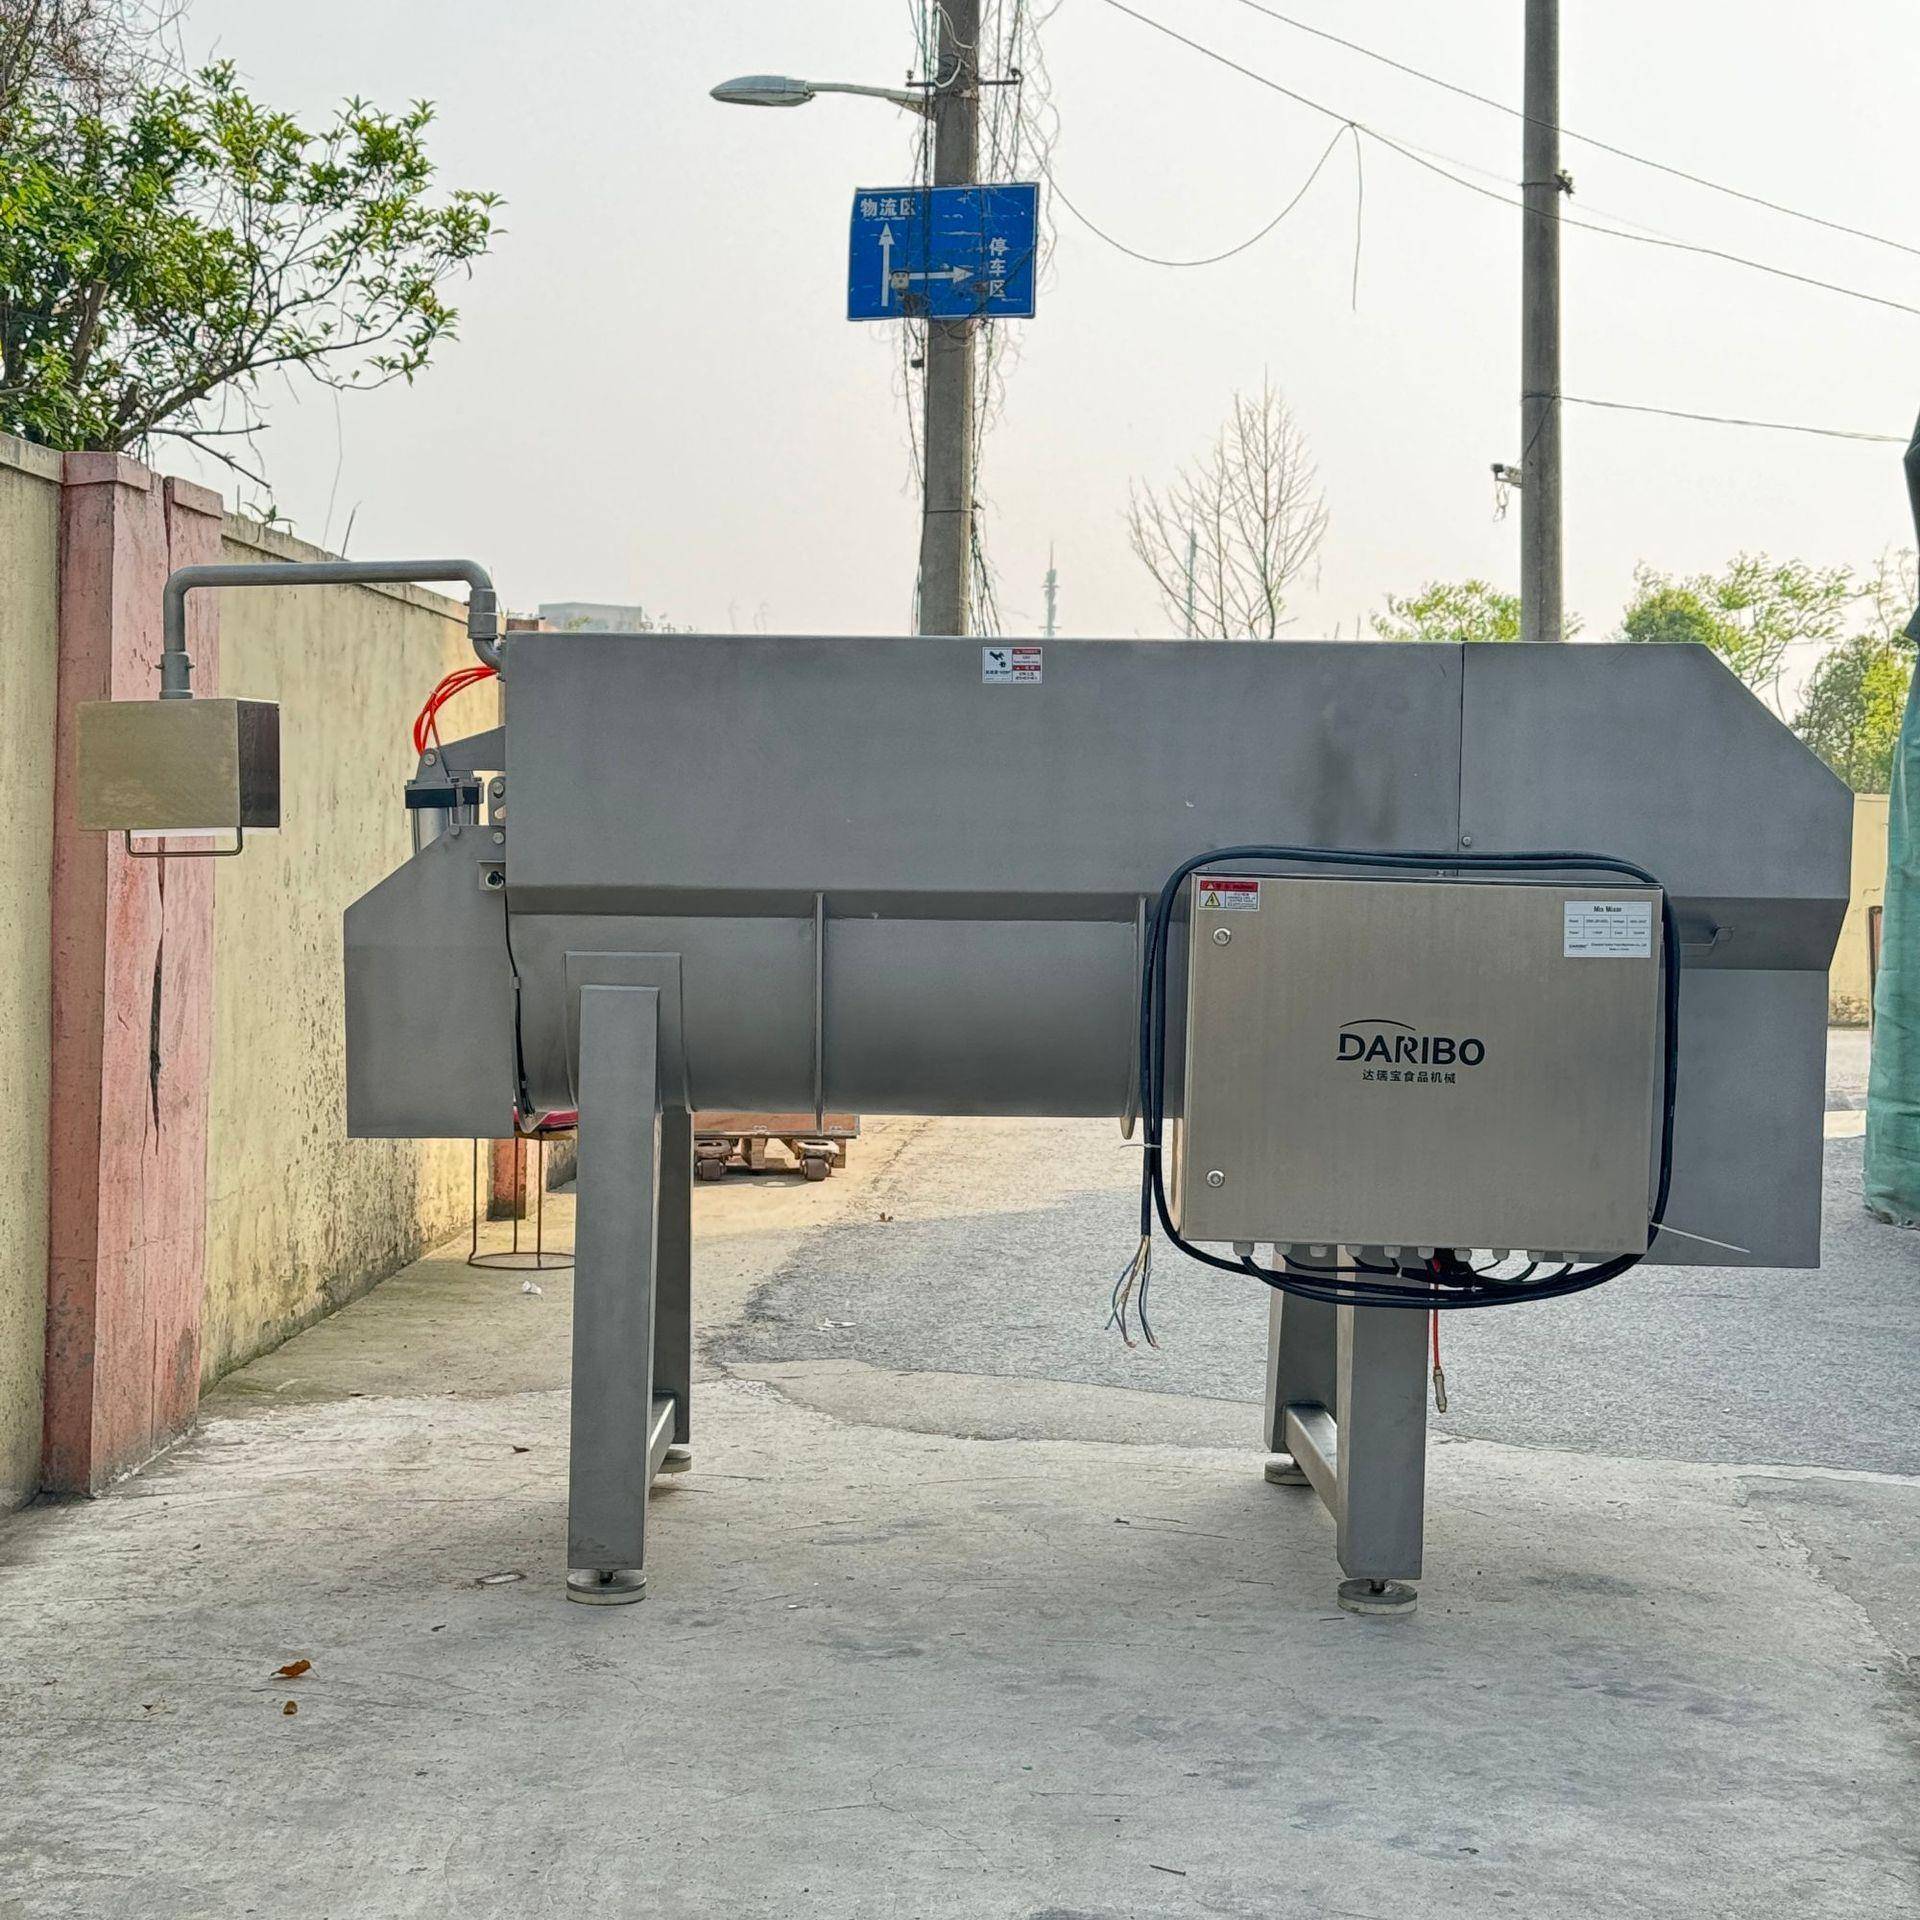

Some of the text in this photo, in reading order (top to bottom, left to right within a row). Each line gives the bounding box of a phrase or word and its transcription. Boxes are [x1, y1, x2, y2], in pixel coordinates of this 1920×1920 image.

[860, 197, 916, 217] 物流区
[988, 237, 1010, 298] 停车区
[1335, 1033, 1485, 1066] DARIBO
[1362, 1068, 1456, 1084] 达瑞宝食品机械
